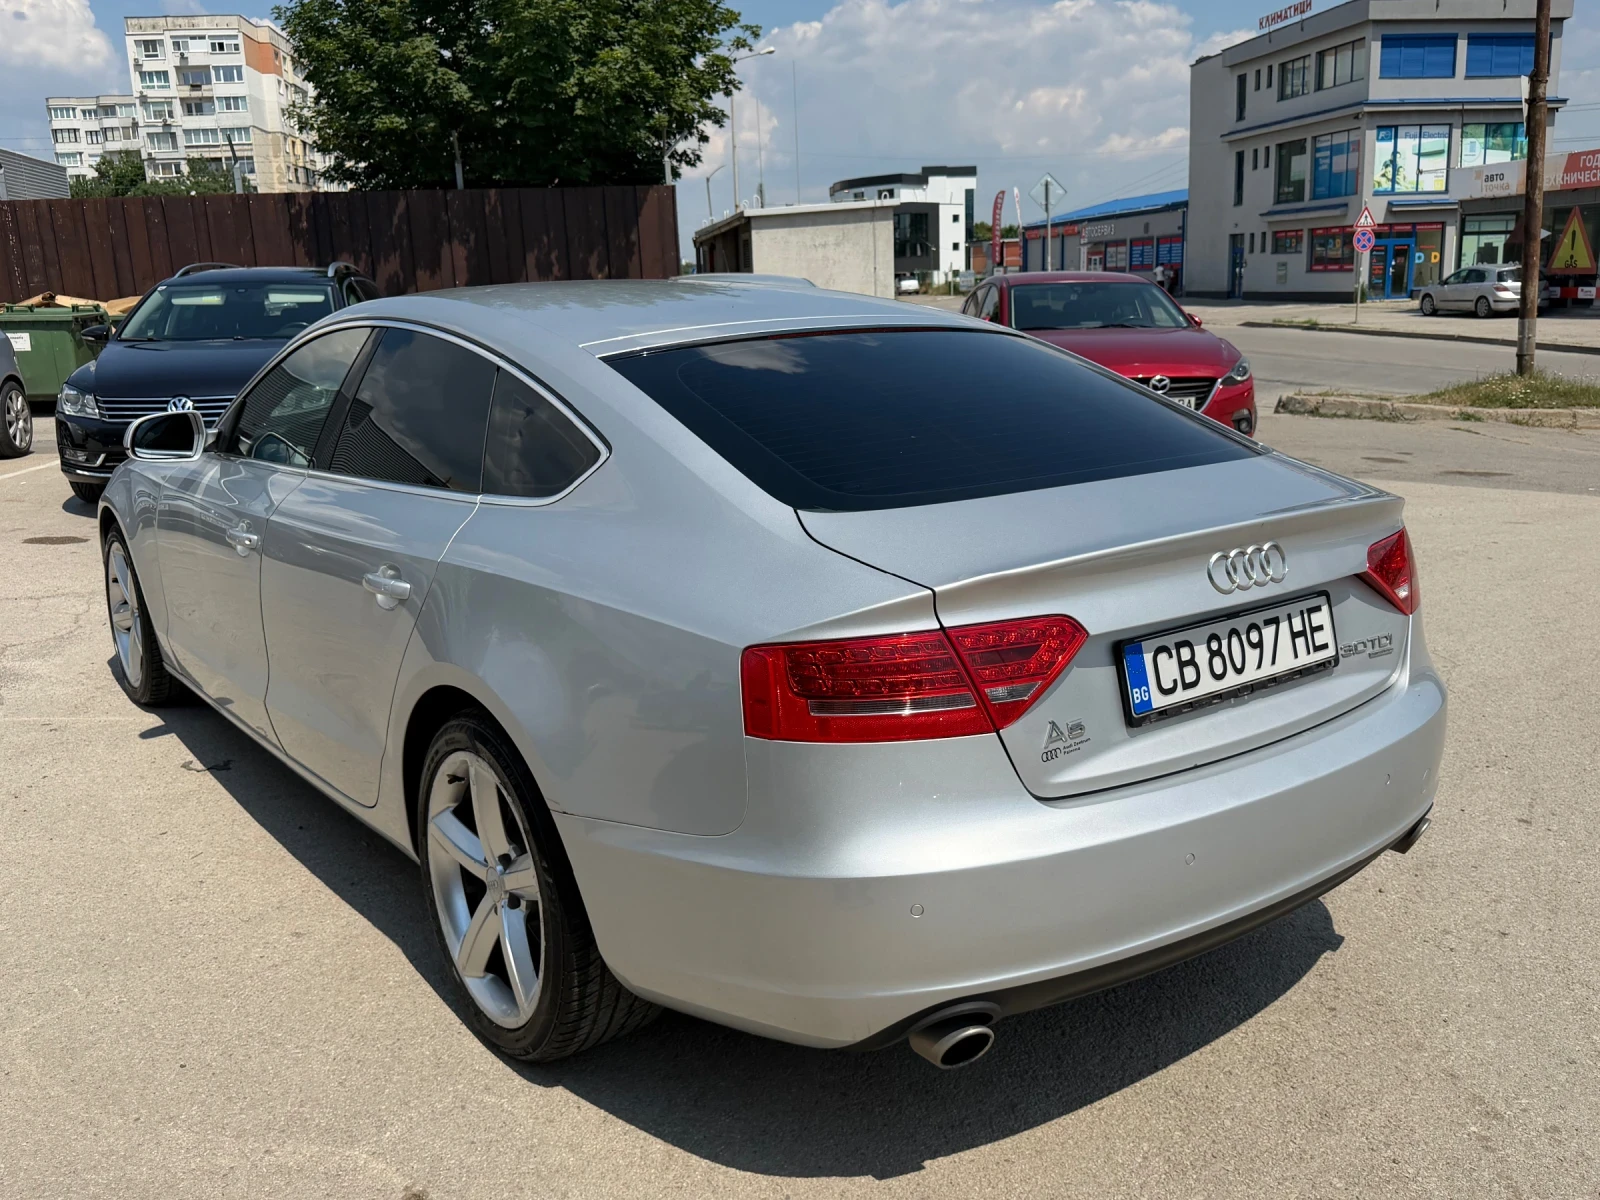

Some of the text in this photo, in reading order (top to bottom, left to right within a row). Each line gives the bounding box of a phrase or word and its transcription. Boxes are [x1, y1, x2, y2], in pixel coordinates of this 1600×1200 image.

[1259, 0, 1312, 30] КЛИМАТИЦИ
[1405, 131, 1418, 140] Fuji
[1484, 172, 1505, 183] авто
[1484, 182, 1510, 193] точка
[1564, 259, 1578, 269] GAS
[1152, 605, 1329, 696] CB 8097 HE
[1132, 686, 1149, 704] BG
[1043, 718, 1086, 749] A5
[1062, 743, 1073, 751] Audi
